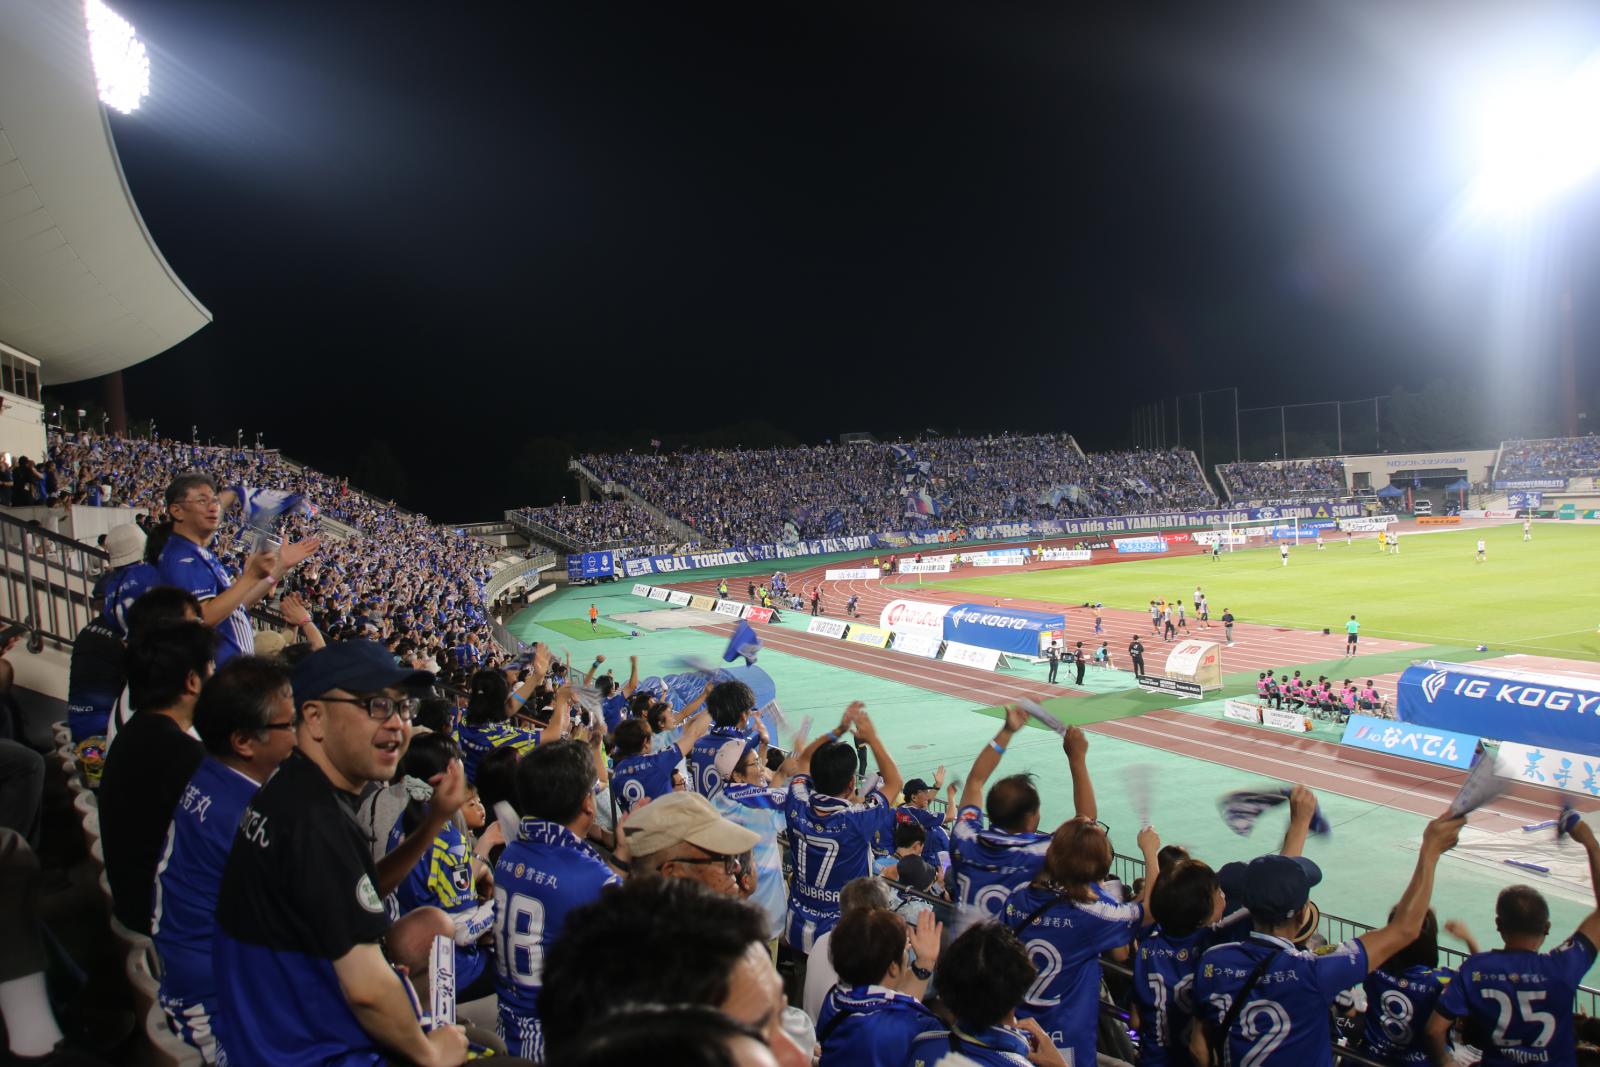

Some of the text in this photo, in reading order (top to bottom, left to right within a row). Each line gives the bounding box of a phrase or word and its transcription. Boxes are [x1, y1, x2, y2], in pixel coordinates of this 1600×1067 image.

[1281, 503, 1360, 519] DEWA SOUL
[1065, 521, 1079, 534] La
[1081, 519, 1105, 532] vida
[1107, 518, 1125, 530] sin
[1126, 514, 1187, 530] YAMAGATA
[655, 555, 692, 573] REAL
[691, 551, 749, 569] TOHOKU
[979, 613, 1028, 630] KOGYO
[1453, 677, 1600, 716] IG KOGY
[1380, 725, 1460, 762] なべでん
[792, 828, 840, 889] 17
[525, 867, 558, 890] 雪若丸
[796, 881, 840, 903] SUBASA
[1379, 989, 1414, 1045] 8
[1480, 988, 1557, 1048] 25
